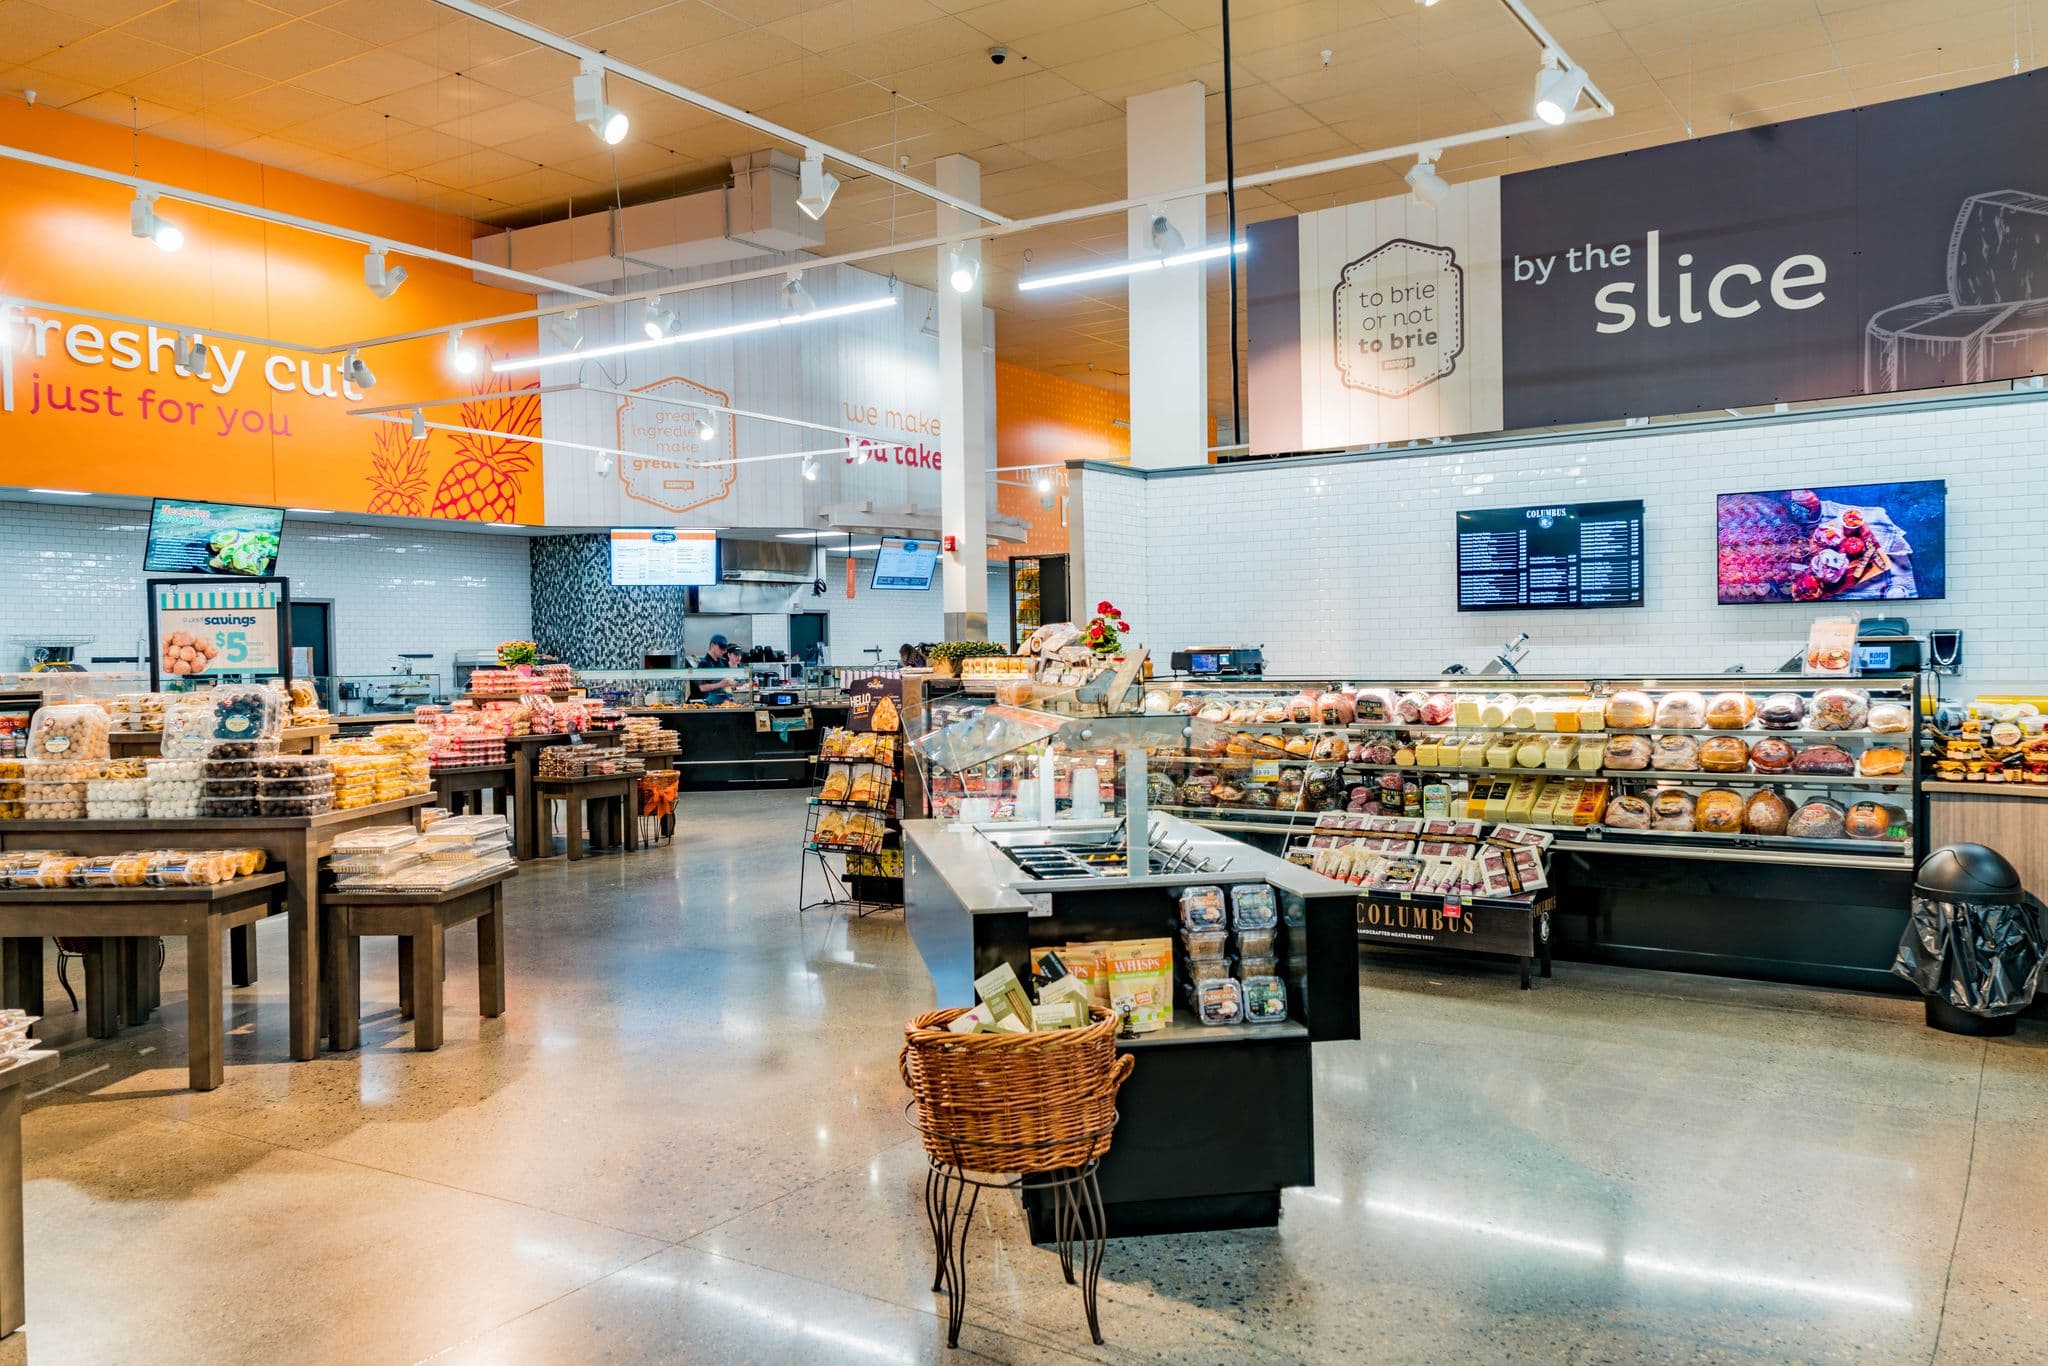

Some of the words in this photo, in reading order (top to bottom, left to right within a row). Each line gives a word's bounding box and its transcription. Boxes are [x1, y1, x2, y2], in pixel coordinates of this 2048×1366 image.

[1514, 254, 1556, 285] by
[1566, 243, 1632, 273] the
[1595, 229, 1827, 334] slice
[1359, 292, 1383, 308] to
[1391, 282, 1435, 303] brie
[1362, 315, 1387, 330] or
[1394, 305, 1433, 326] not
[1358, 338, 1383, 354] to
[1390, 328, 1438, 350] brie
[264, 354, 364, 401] cut
[30, 372, 123, 417] just
[138, 388, 204, 425] for
[217, 405, 293, 437] you
[656, 411, 696, 424] great
[633, 425, 697, 439] ingredie
[843, 402, 878, 426] we
[885, 410, 941, 437] make
[656, 441, 699, 453] make
[894, 443, 942, 471] take
[1526, 508, 1567, 518] COLUMBUS
[204, 614, 256, 627] savings
[215, 631, 248, 663] $5
[850, 692, 871, 707] HELLO
[1356, 902, 1474, 934] COLUMBUS
[1114, 958, 1161, 973] WHISPS
